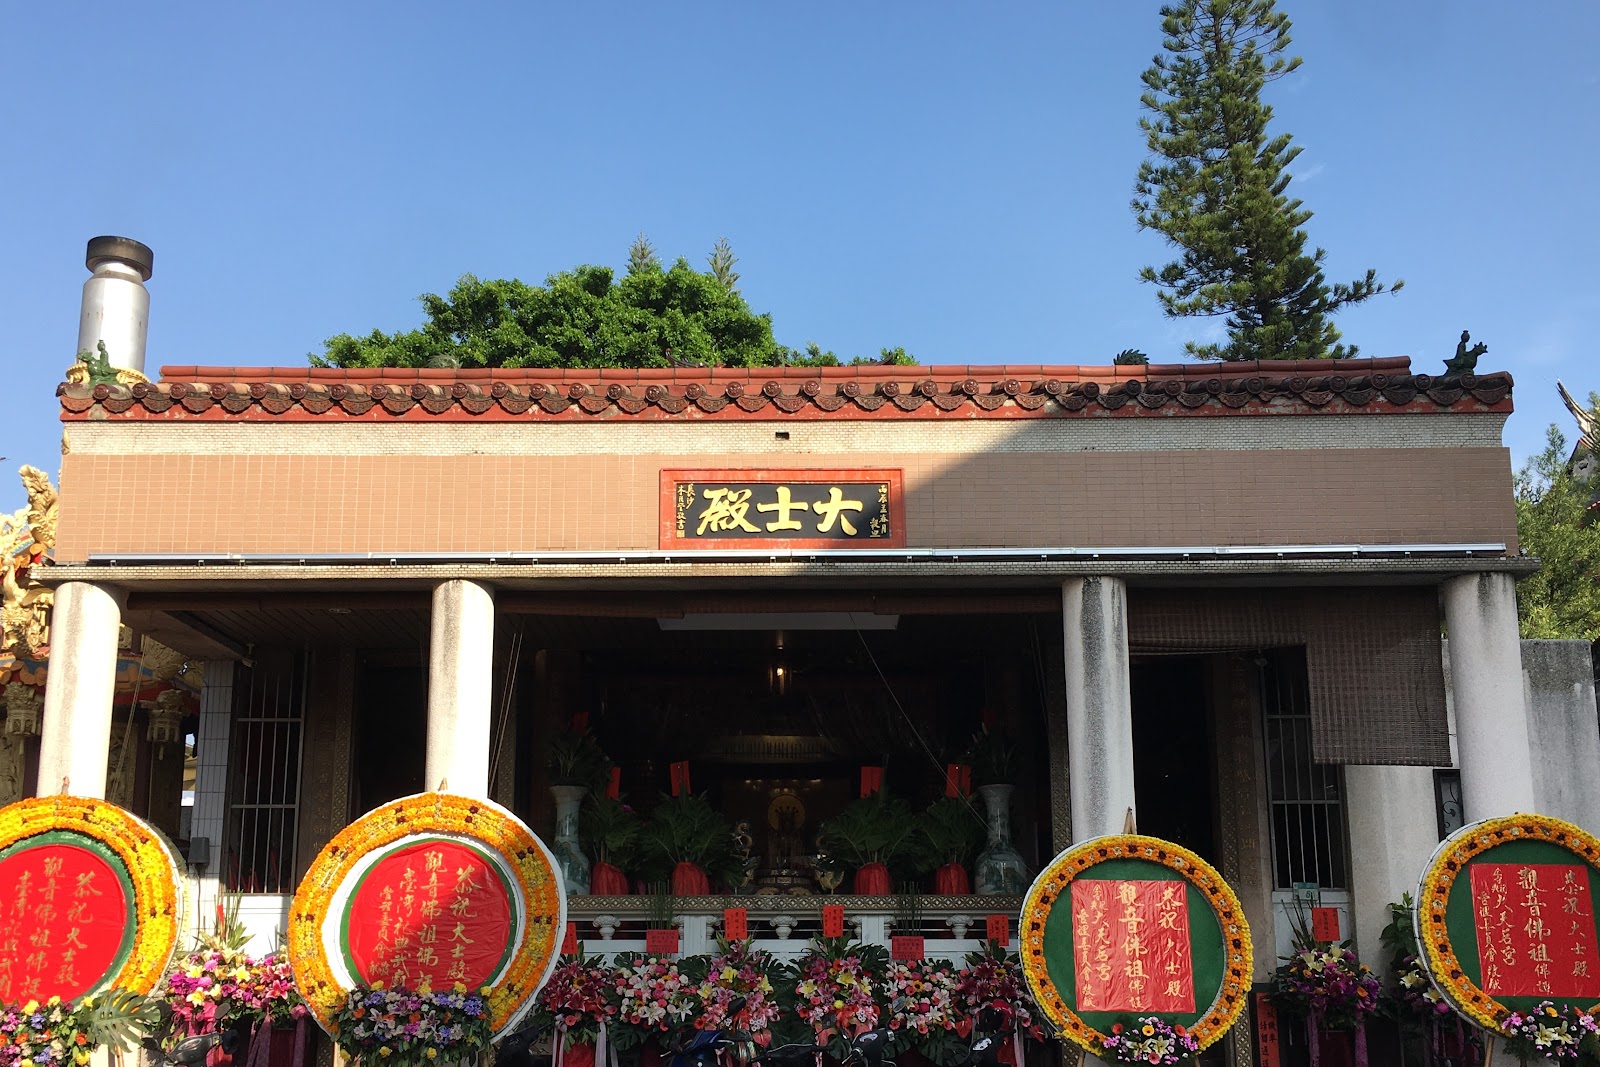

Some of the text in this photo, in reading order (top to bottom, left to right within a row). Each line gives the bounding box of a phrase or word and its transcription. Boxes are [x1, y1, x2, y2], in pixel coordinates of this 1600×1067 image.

[696, 486, 863, 536] 大士殿
[20, 856, 65, 998] 觀音佛祖佛誕
[54, 871, 102, 986] 恭祝大士殿
[445, 864, 482, 982] 恭祝大士殿
[1115, 882, 1150, 1009] 觀音佛祖佛誕
[1155, 886, 1186, 998] 恭祝大士殿
[1516, 866, 1554, 995] 觀音佛祖佛誕
[1557, 870, 1591, 978] 恭祝大士殿
